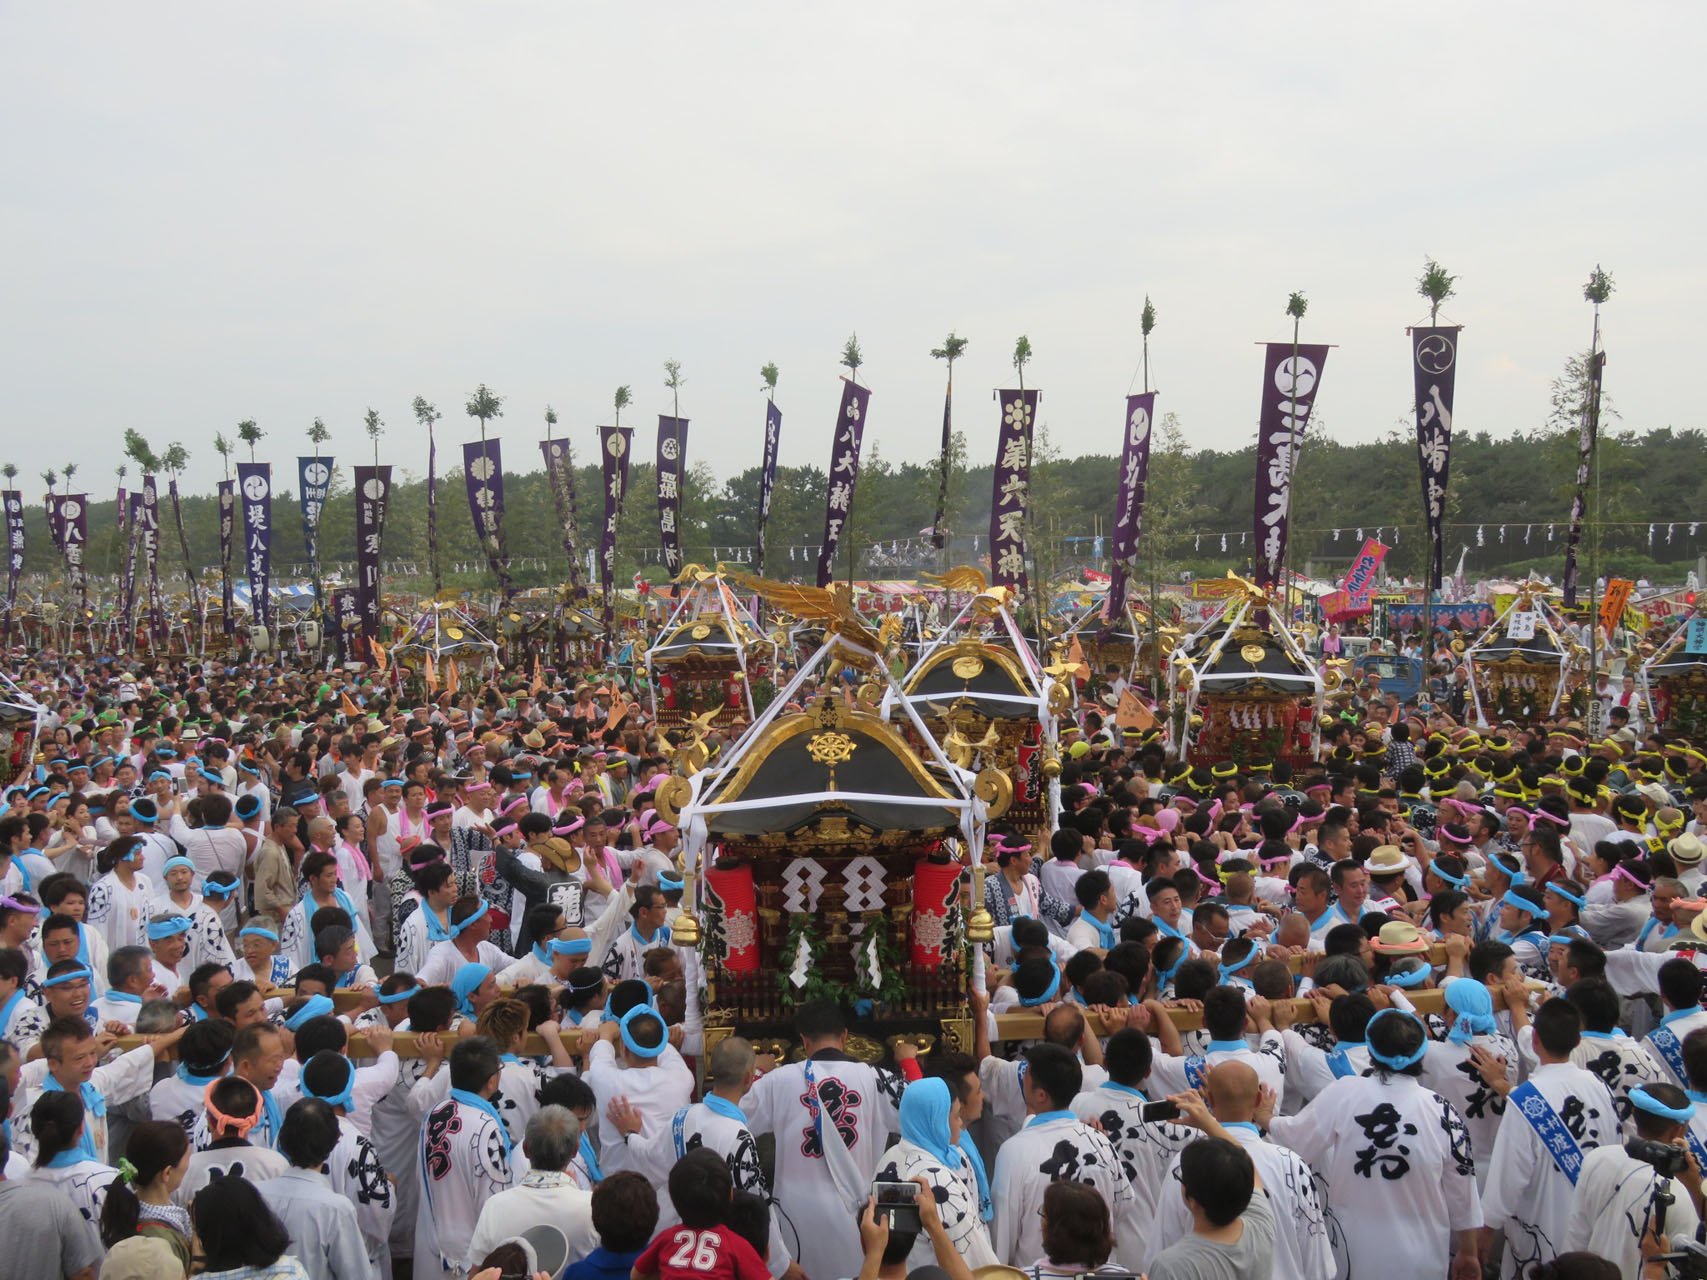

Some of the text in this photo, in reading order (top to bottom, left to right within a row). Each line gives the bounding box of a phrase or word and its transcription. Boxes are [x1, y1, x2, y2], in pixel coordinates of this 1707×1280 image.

[826, 425, 857, 574] 八大龍王
[667, 1230, 722, 1272] 26
